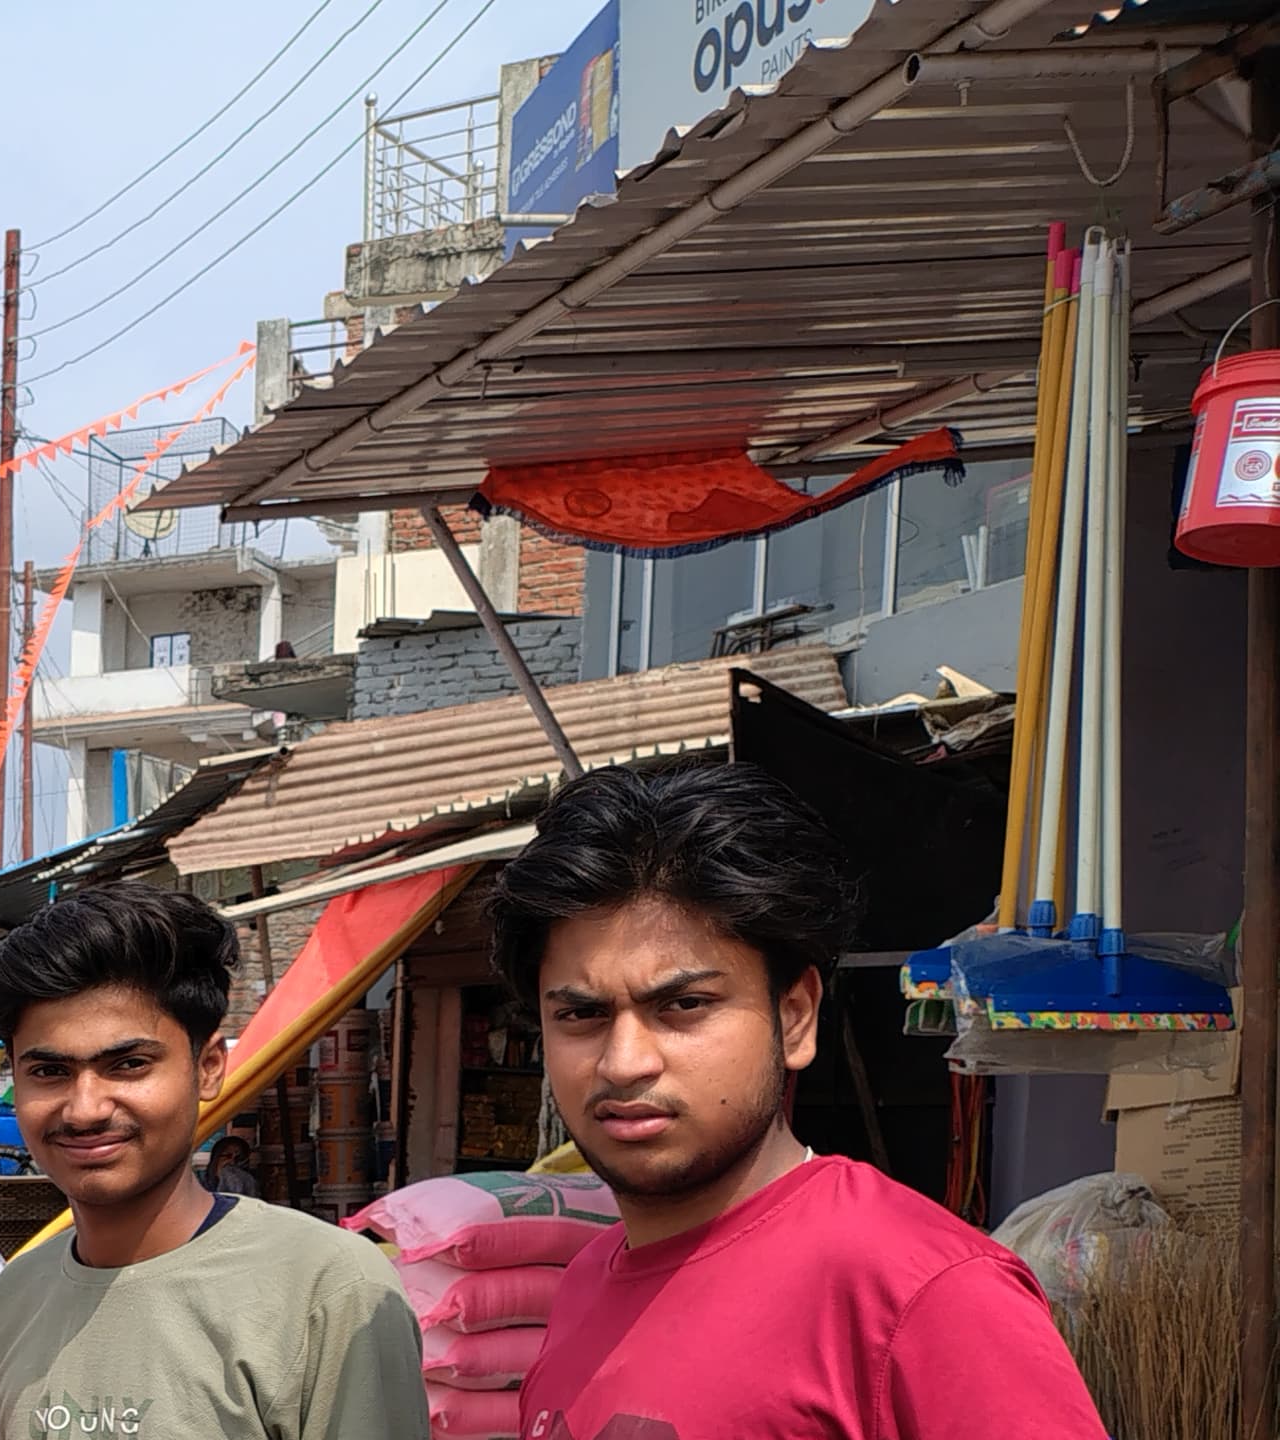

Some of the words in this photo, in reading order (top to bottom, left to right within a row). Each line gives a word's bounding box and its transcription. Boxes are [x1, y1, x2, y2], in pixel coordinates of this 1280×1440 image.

[694, 0, 813, 93] opus
[761, 28, 813, 83] PAINTS
[35, 1405, 140, 1434] YOUNG
